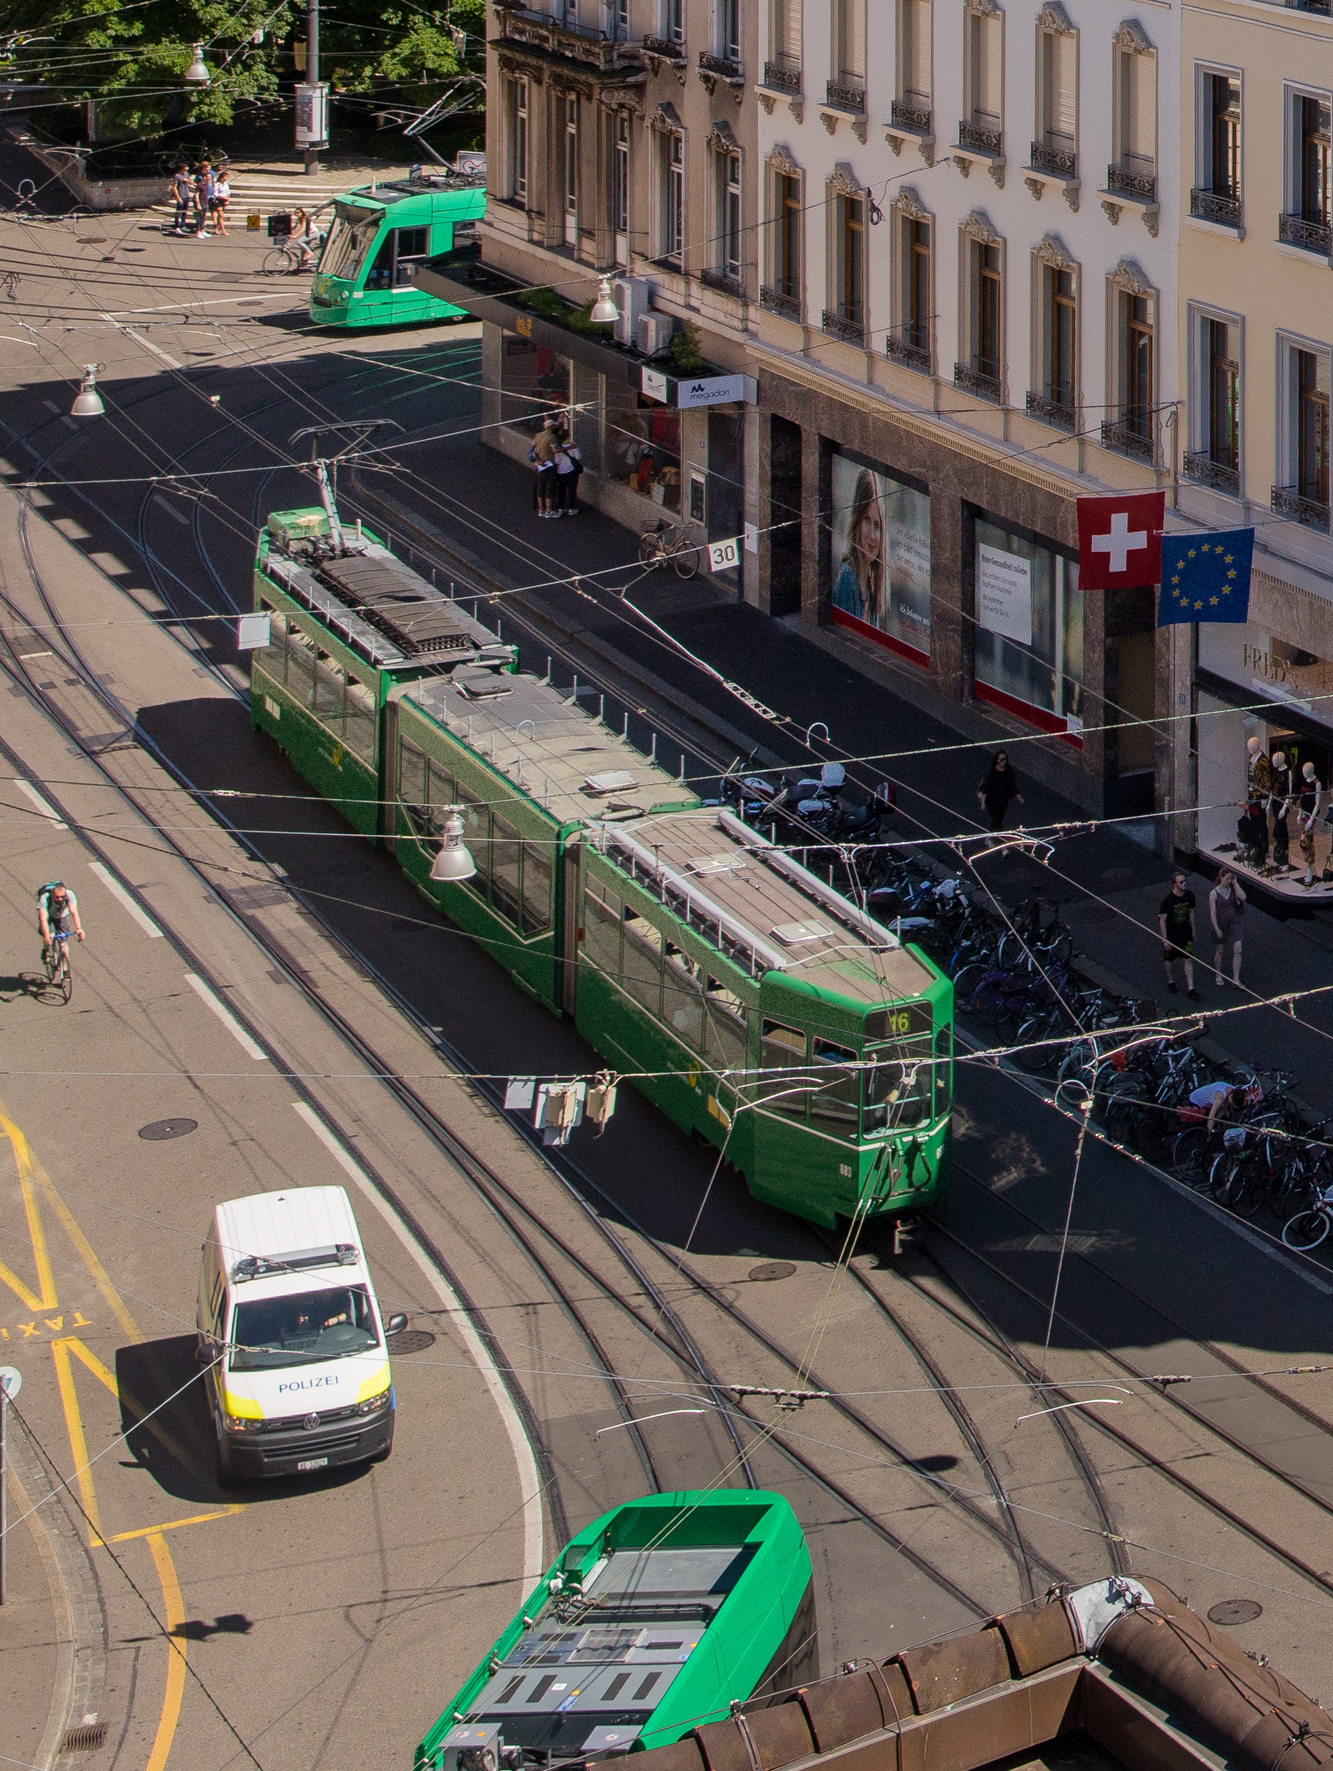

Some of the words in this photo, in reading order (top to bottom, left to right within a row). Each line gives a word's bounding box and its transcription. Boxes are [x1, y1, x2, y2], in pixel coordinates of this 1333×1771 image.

[689, 389, 731, 401] megadon
[713, 544, 736, 565] 30
[889, 1012, 909, 1033] 16
[0, 1312, 92, 1341] TAXI
[278, 1375, 339, 1394] POLIZEI
